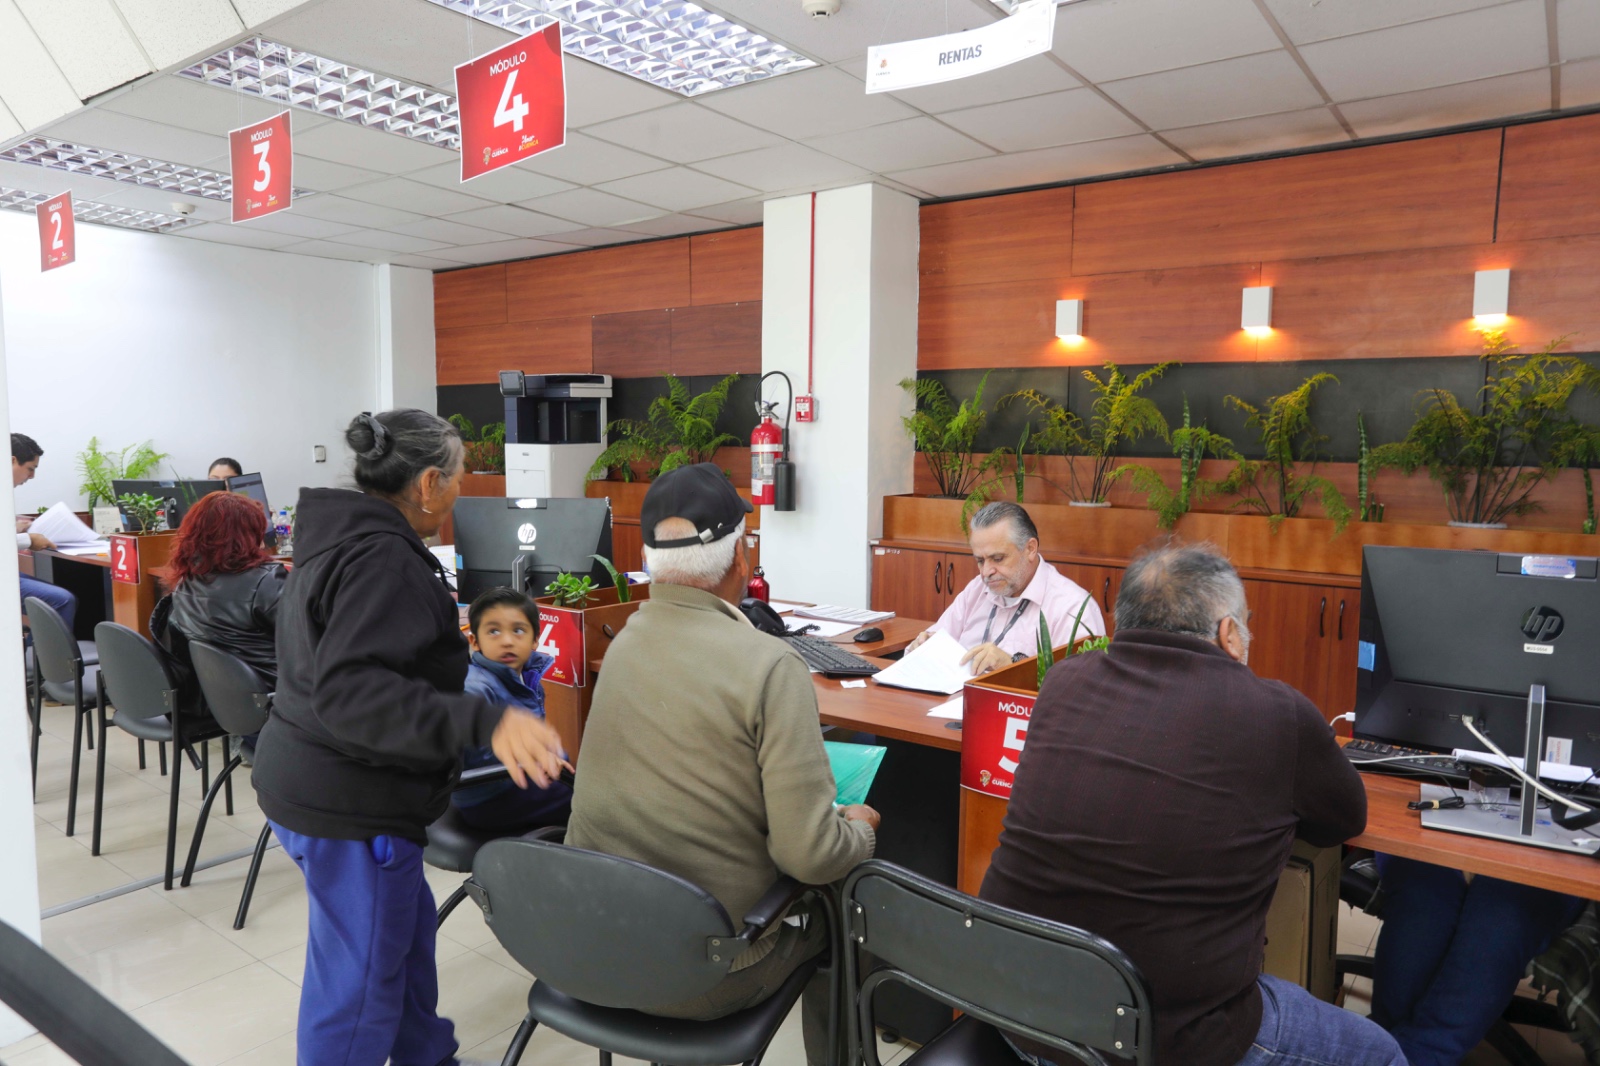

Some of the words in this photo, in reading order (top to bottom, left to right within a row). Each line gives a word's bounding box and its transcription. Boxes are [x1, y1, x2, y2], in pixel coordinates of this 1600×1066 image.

[489, 51, 528, 77] MÓDULO
[938, 44, 983, 66] RENTAS
[493, 69, 530, 133] 4
[250, 127, 274, 143] MÓDULO
[252, 140, 272, 192] 3
[50, 211, 64, 250] 2
[116, 544, 127, 571] 2
[539, 611, 560, 624] ÓDULO
[1523, 606, 1561, 642] hp
[535, 623, 560, 664] 4
[998, 701, 1034, 717] MÓDU
[998, 716, 1030, 775] 5
